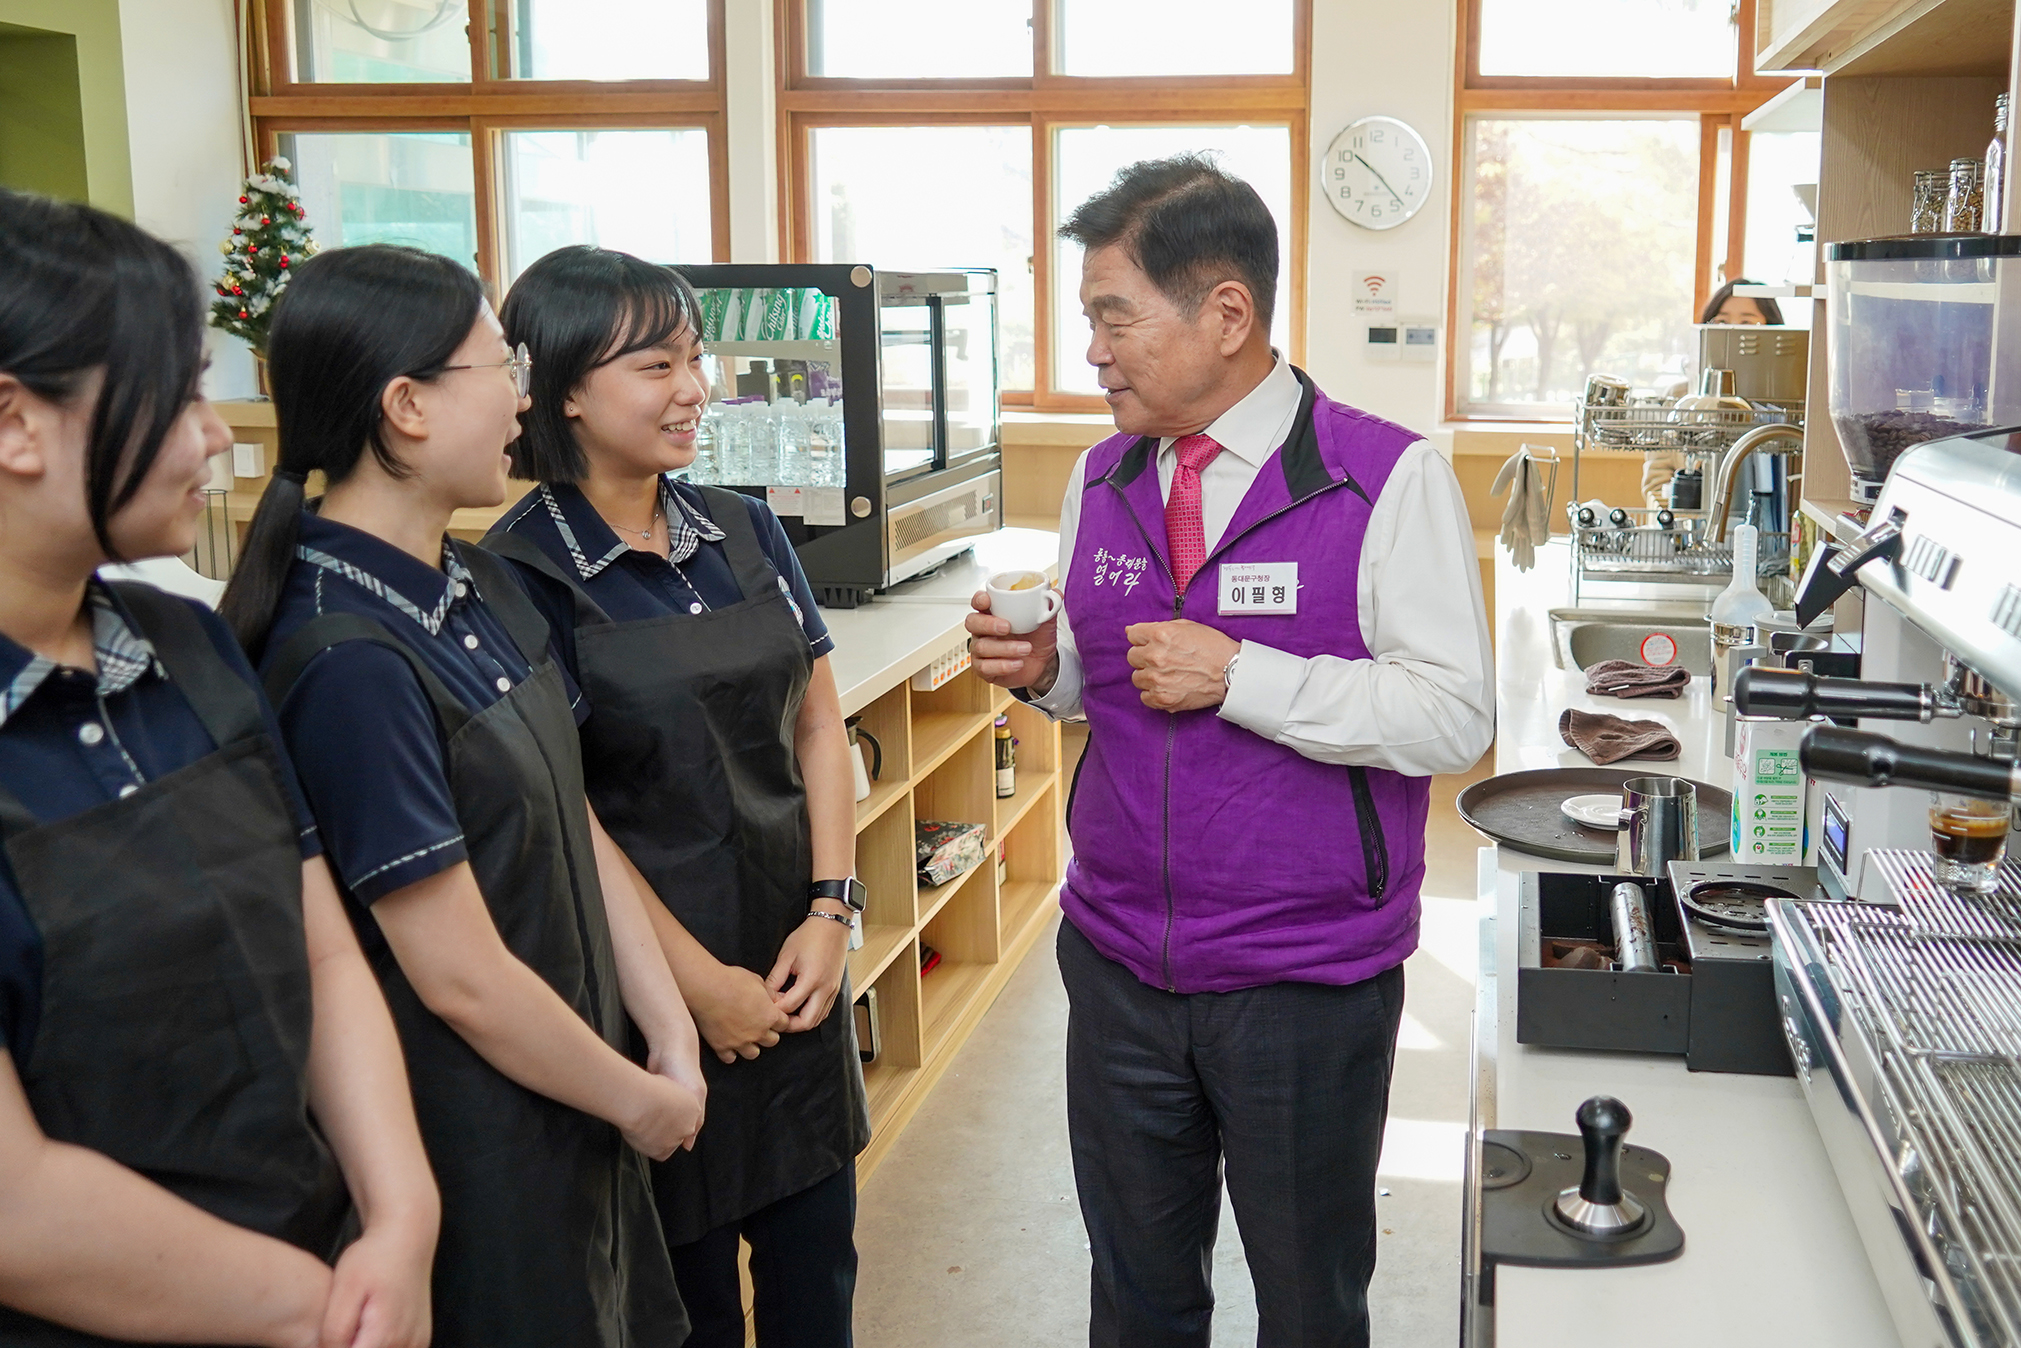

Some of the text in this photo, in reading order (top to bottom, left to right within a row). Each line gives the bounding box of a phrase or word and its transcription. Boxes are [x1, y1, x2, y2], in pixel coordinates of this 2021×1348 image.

[1353, 136, 1363, 149] 11
[1369, 129, 1385, 143] 12
[1338, 149, 1353, 163] 10
[1403, 148, 1414, 161] 2
[1334, 167, 1346, 180] 9
[1410, 166, 1420, 180] 3
[1340, 186, 1351, 199] 8
[1355, 200, 1364, 213] 7
[1371, 204, 1382, 217] 6
[1390, 200, 1400, 212] 5
[765, 293, 787, 341] Chilsung
[1231, 574, 1271, 583] 동대문구청장
